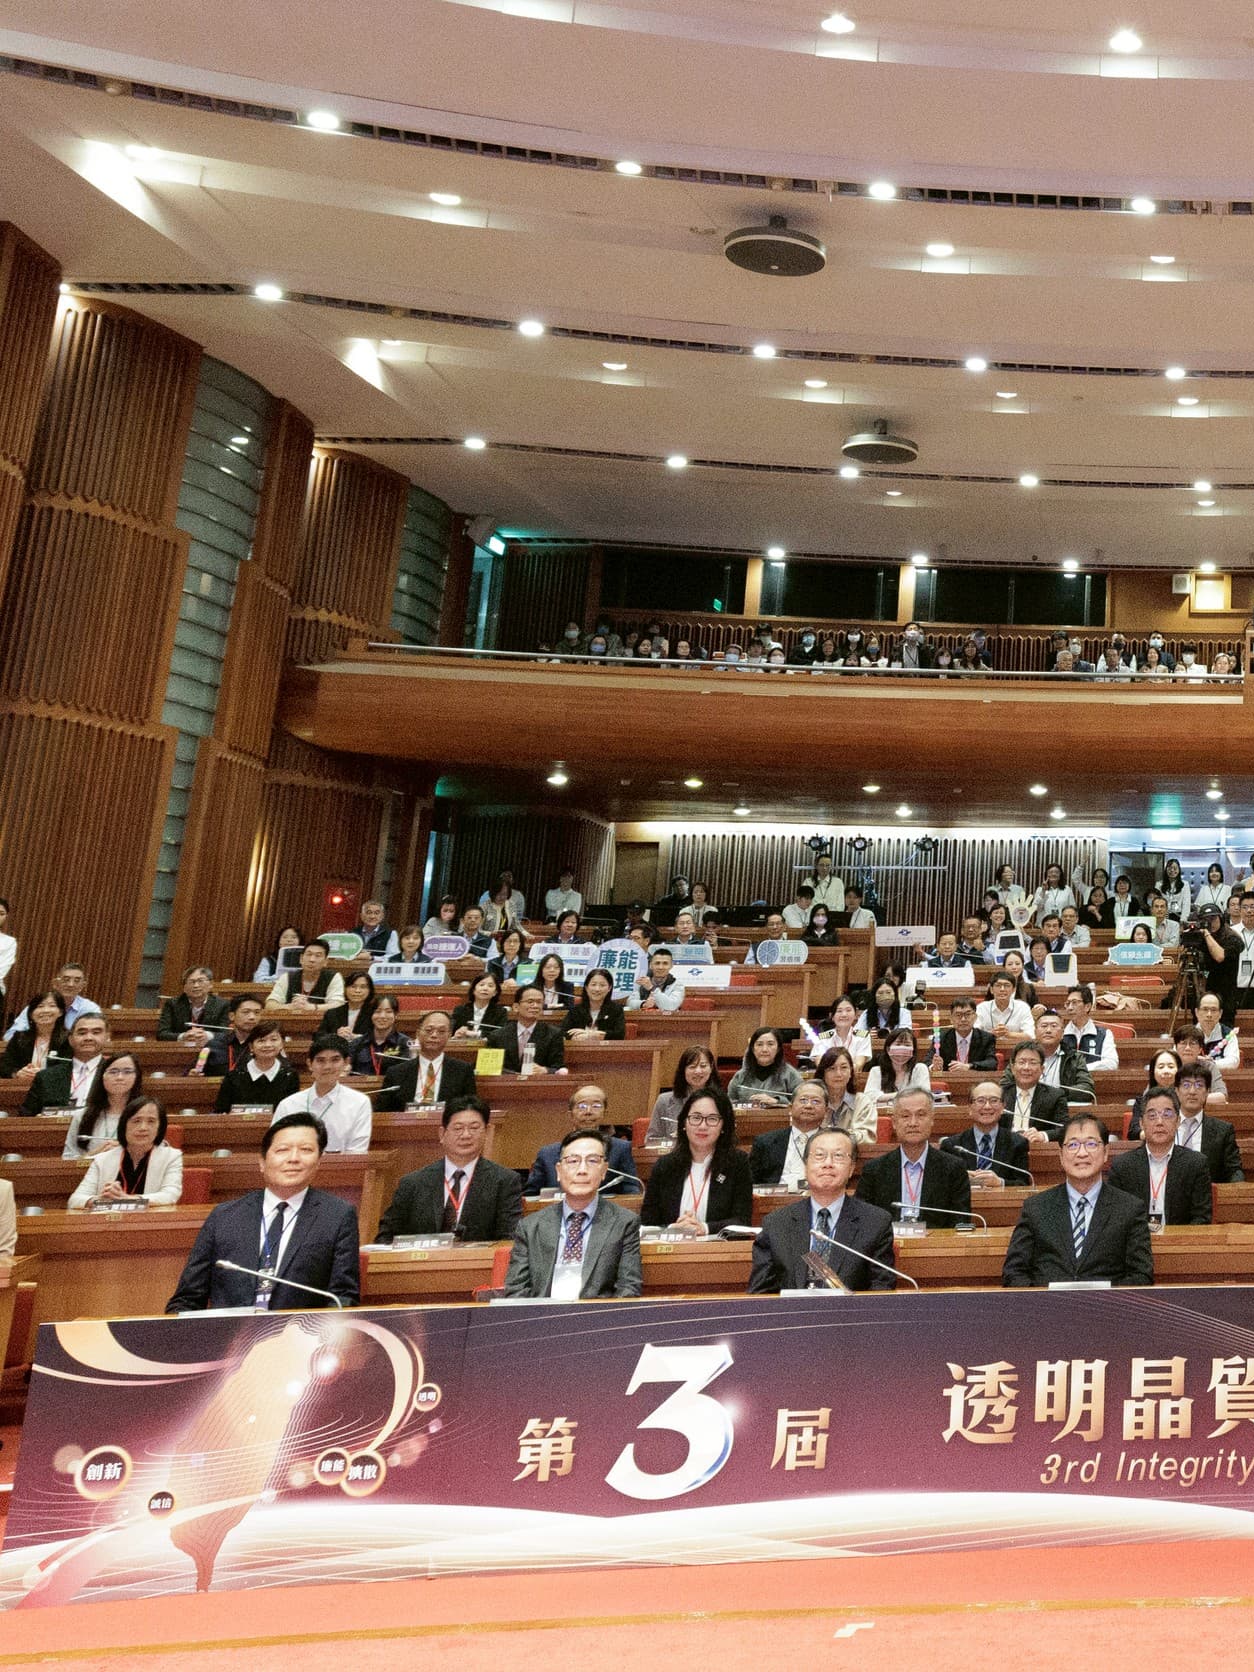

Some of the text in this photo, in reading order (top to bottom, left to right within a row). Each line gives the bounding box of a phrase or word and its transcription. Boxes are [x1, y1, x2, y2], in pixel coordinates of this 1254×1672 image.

[597, 949, 638, 969] 廉能
[513, 1343, 832, 1500] 第 3 屆
[86, 1461, 122, 1481] 創新
[1040, 1452, 1101, 1484] 3rd
